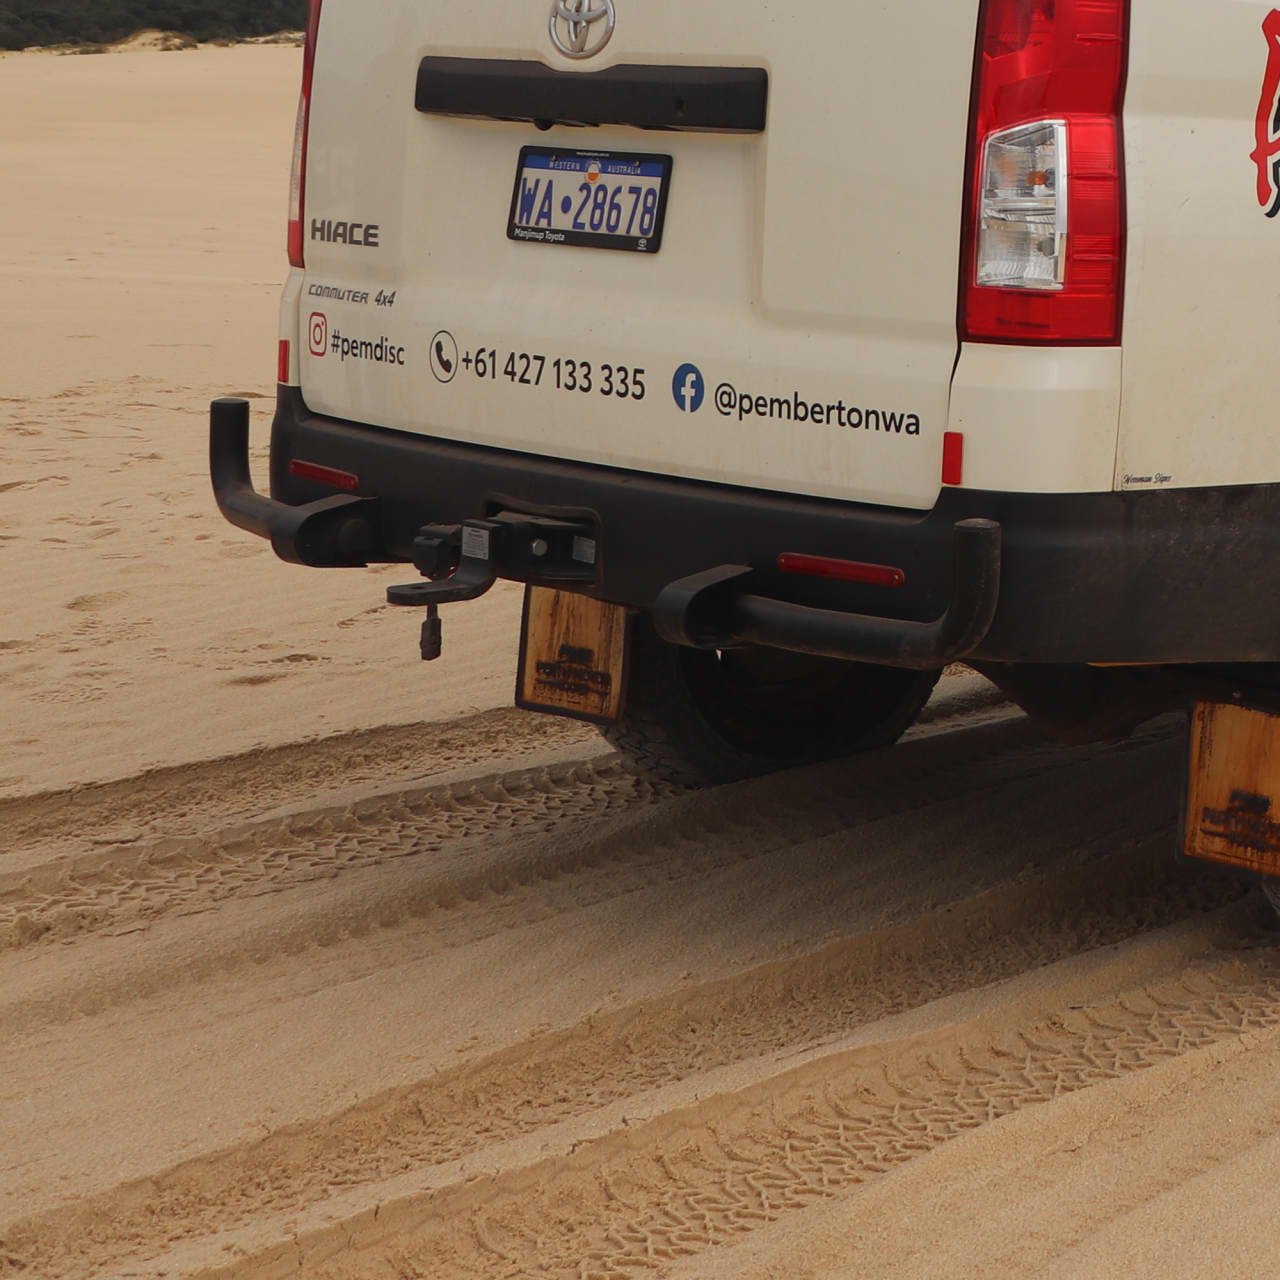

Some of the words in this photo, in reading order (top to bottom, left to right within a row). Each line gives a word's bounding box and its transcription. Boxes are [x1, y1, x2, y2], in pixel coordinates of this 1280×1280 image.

[550, 160, 581, 171] WESTERN
[607, 165, 641, 175] AUSTRALIA
[311, 218, 380, 247] HIACE
[513, 228, 545, 241] Manjimup
[545, 230, 565, 243] Toyota
[308, 284, 369, 305] COMMUTER
[375, 288, 397, 308] 4x4
[331, 328, 405, 366] #pemdisc
[462, 348, 497, 380] +61
[503, 351, 546, 387] 427
[552, 357, 593, 394] 133
[600, 363, 647, 401] 335
[714, 382, 921, 436] @pembertonwa
